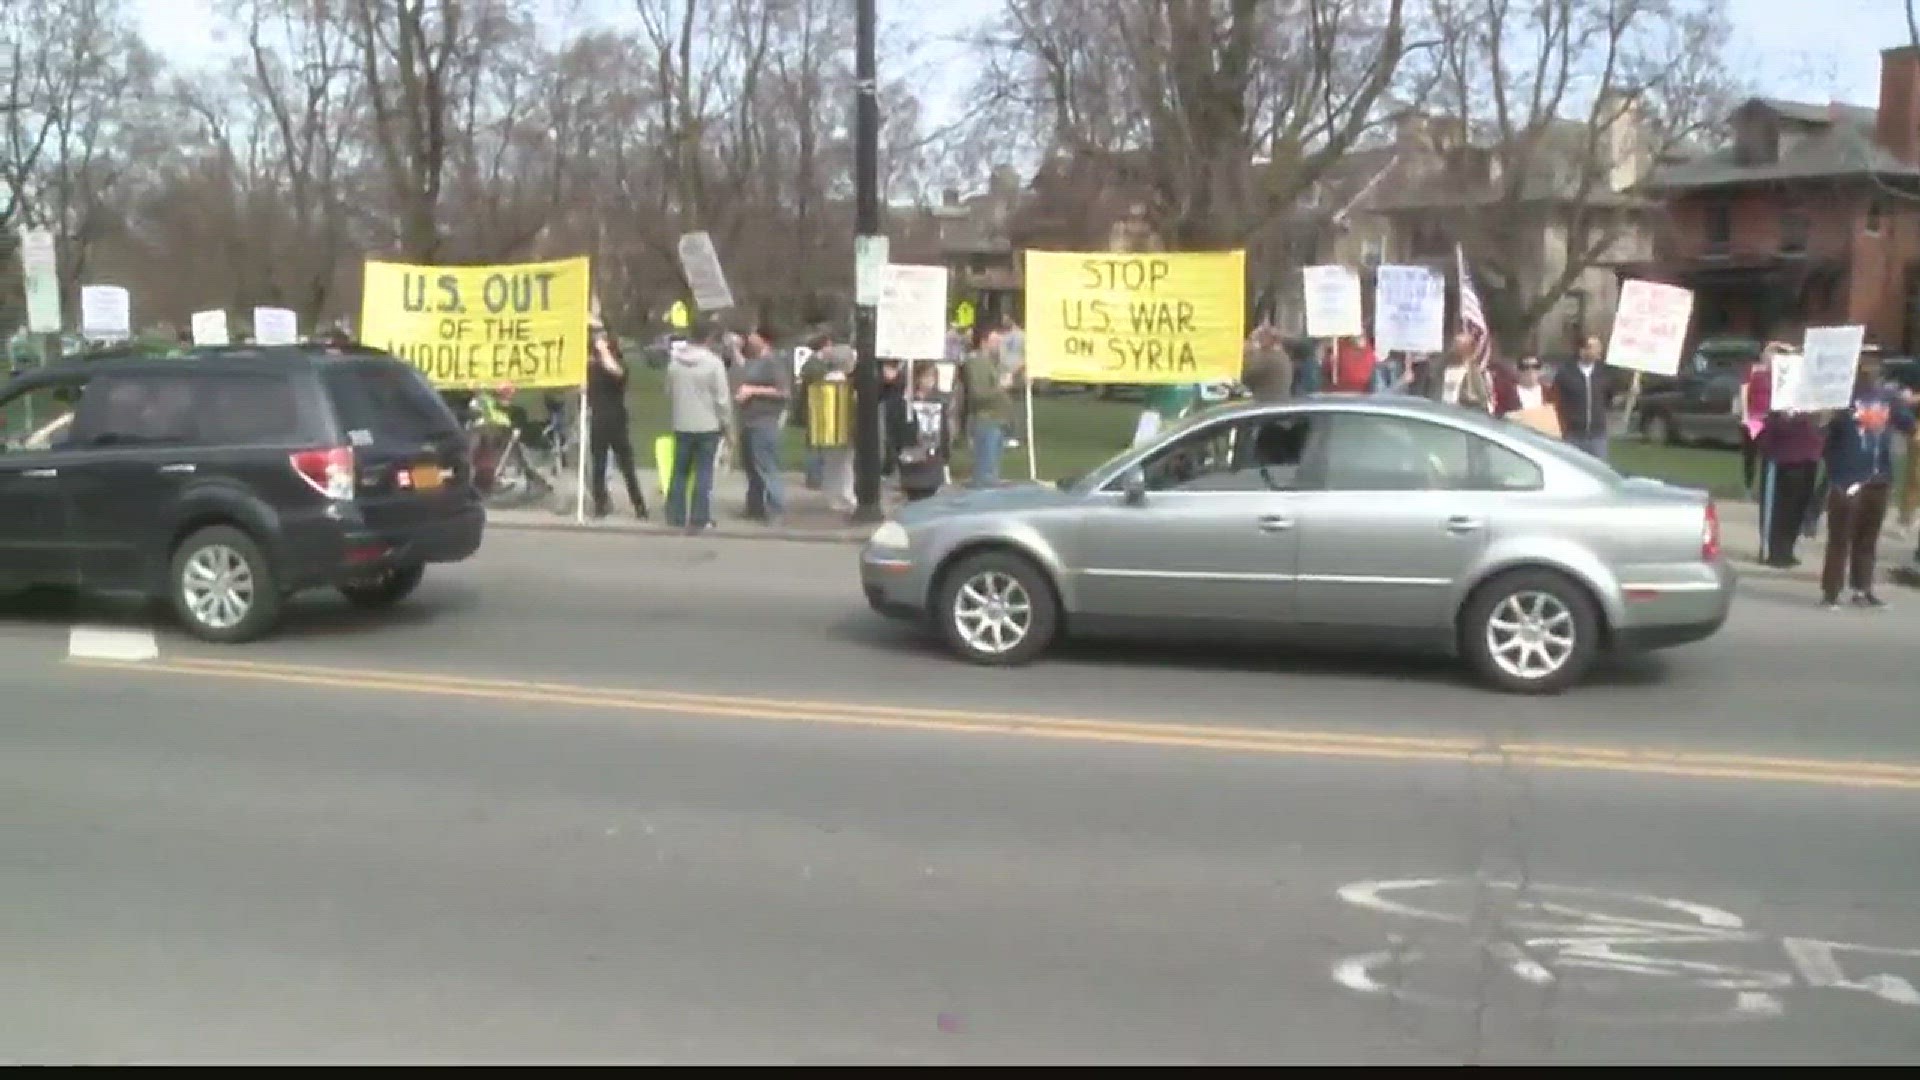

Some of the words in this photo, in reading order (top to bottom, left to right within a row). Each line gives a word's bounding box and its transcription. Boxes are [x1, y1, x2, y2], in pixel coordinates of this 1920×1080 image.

[403, 272, 467, 313] U.S.
[483, 272, 555, 314] OUT
[1082, 259, 1169, 292] STOP
[439, 318, 473, 341] OF
[484, 318, 533, 342] THE
[1062, 299, 1116, 333] U.S.
[1129, 300, 1197, 334] WAR
[492, 335, 564, 378] EAST!
[1064, 336, 1094, 356] ON
[1106, 338, 1197, 372] SYRIA
